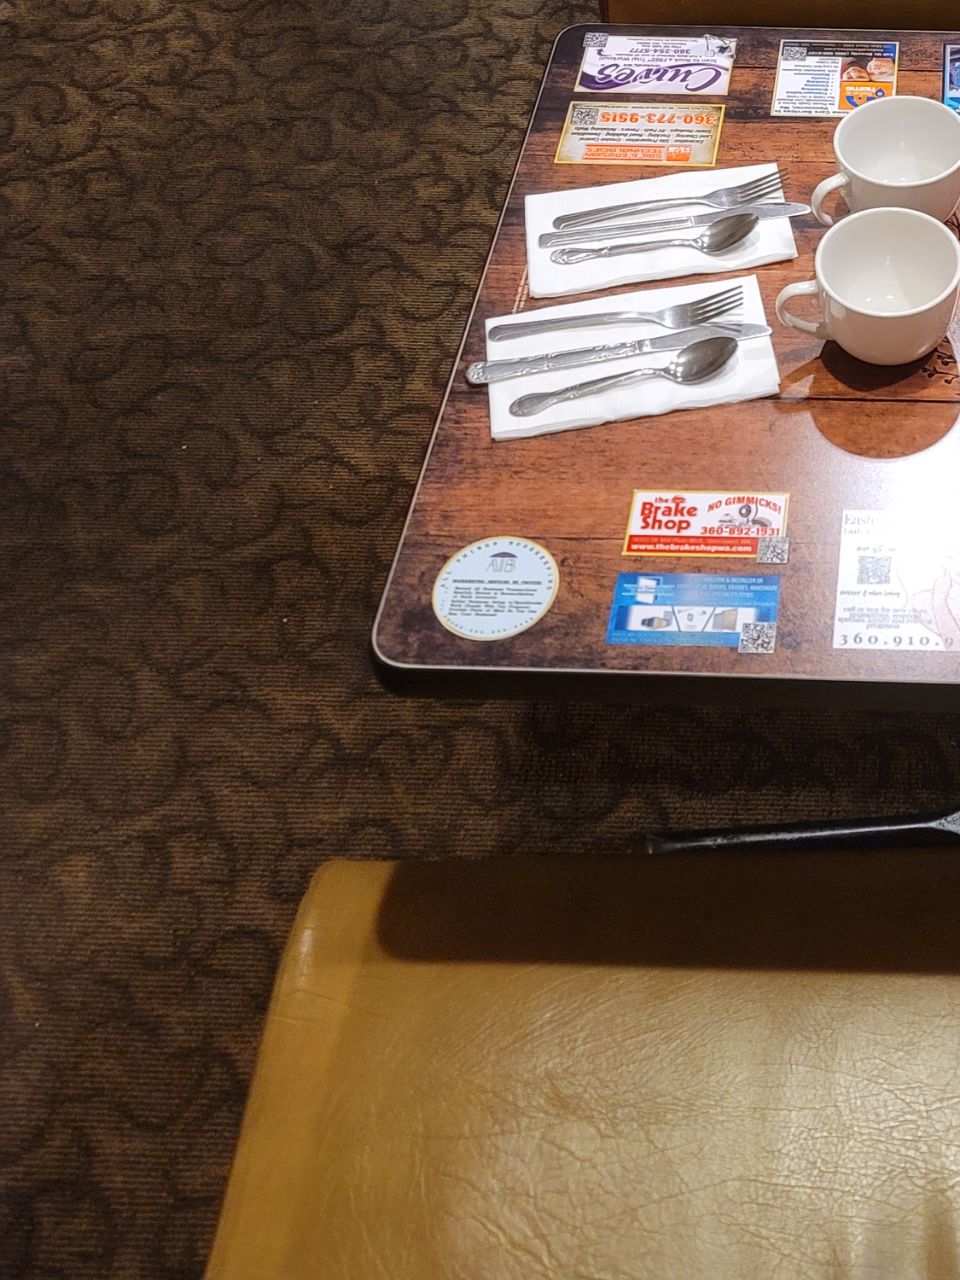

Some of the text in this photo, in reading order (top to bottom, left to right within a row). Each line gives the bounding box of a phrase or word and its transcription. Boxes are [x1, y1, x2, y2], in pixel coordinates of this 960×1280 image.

[597, 64, 722, 92] Curves
[601, 112, 716, 125] 360-773-9515
[640, 501, 698, 517] Brake
[707, 496, 781, 514] NO GIMMICKS!
[640, 515, 691, 533] Shop
[700, 526, 781, 536] 360-892-1931
[631, 543, 753, 553] www.thebrakeshopwa.com
